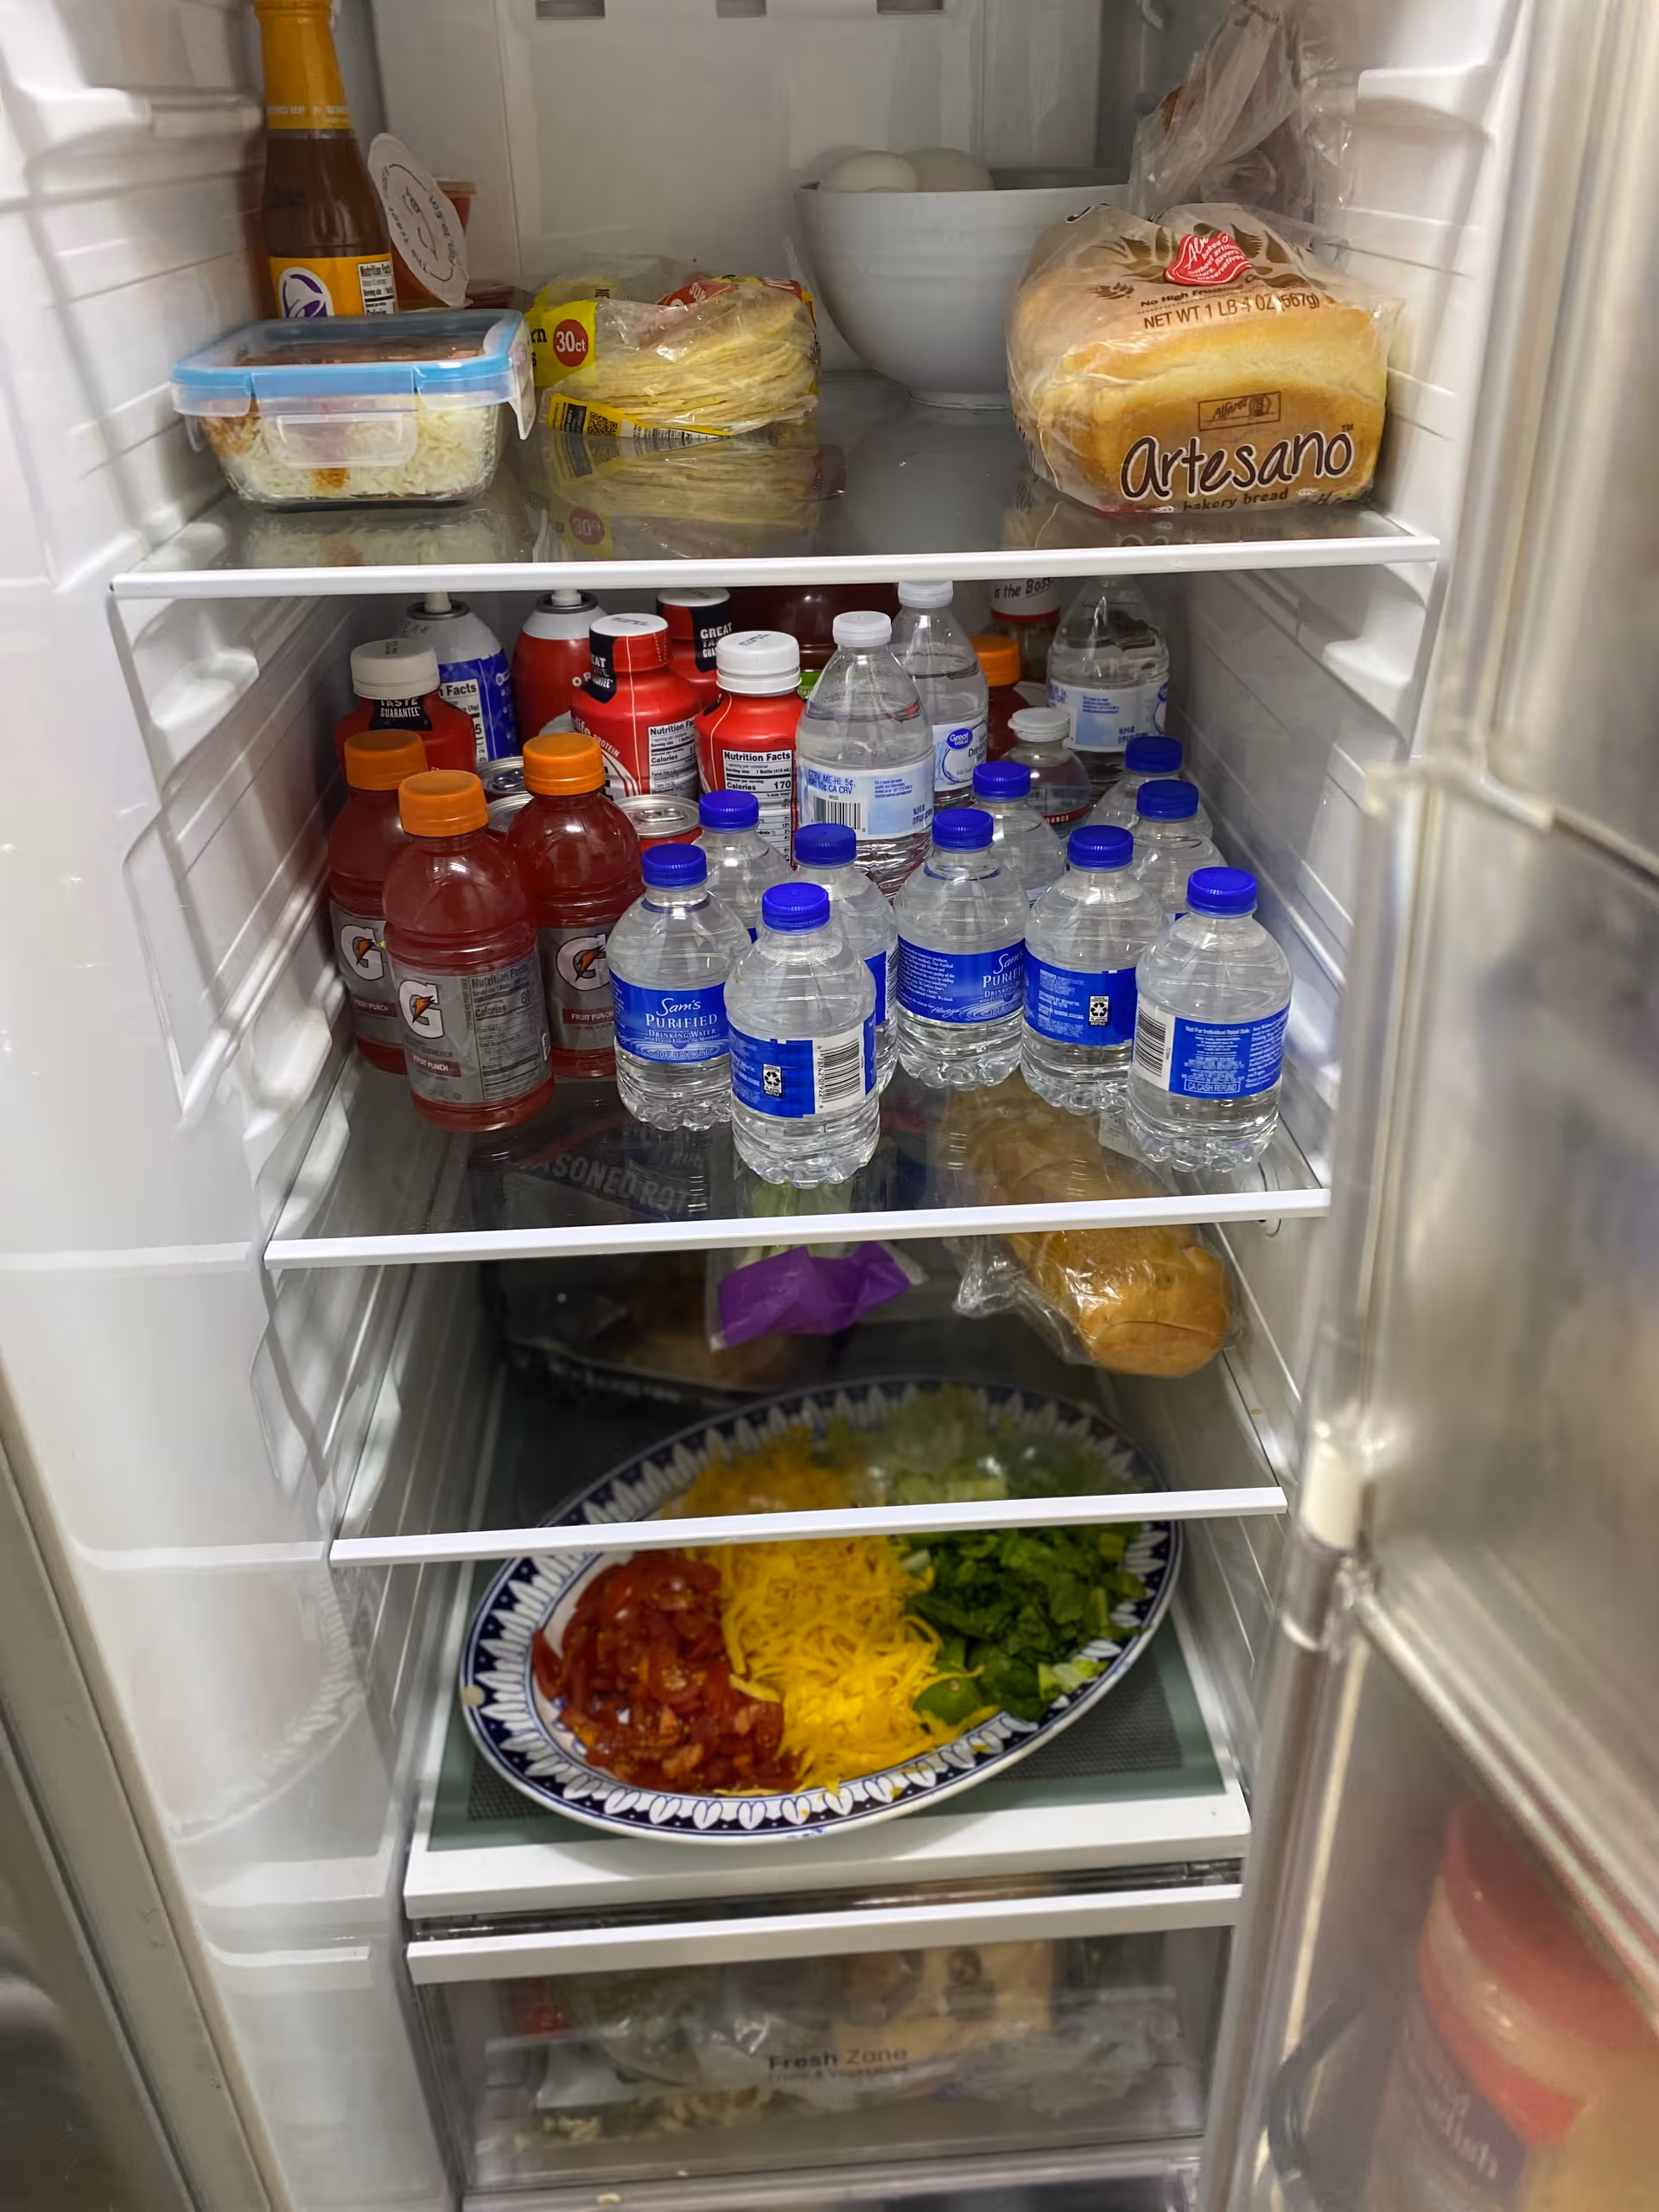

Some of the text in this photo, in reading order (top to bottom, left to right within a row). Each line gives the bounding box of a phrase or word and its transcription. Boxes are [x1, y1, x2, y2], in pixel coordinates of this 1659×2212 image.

[1141, 298, 1160, 308] No
[1161, 292, 1188, 302] High
[1144, 311, 1172, 329] NET
[1176, 305, 1200, 322] WT
[1208, 304, 1213, 318] 1
[1218, 299, 1238, 316] LB
[1255, 294, 1275, 310] OZ
[1279, 293, 1320, 312] (567g)
[556, 330, 587, 353] 30ct
[1183, 488, 1288, 512] bakery bread
[1004, 583, 1021, 599] the
[701, 622, 733, 639] GREAT
[447, 684, 477, 696] Facts
[650, 723, 684, 735] Nutrition
[950, 733, 969, 741] Great
[651, 754, 678, 764] Calories
[723, 751, 791, 762] Nutrition Facts
[727, 780, 791, 791] Calories 170
[472, 973, 509, 988] Nutrition
[368, 1002, 389, 1012] PUNCH
[398, 980, 444, 1039] G
[475, 1006, 506, 1018] Calories
[656, 998, 702, 1016] Sam's
[645, 1014, 718, 1028] PURIFIED
[649, 1028, 716, 1039] DRINKING WATER
[428, 1061, 448, 1071] PUNCH
[1188, 1082, 1197, 1090] CA
[1214, 1084, 1237, 1092] REFUND
[769, 2049, 908, 2070] Fresh Zone
